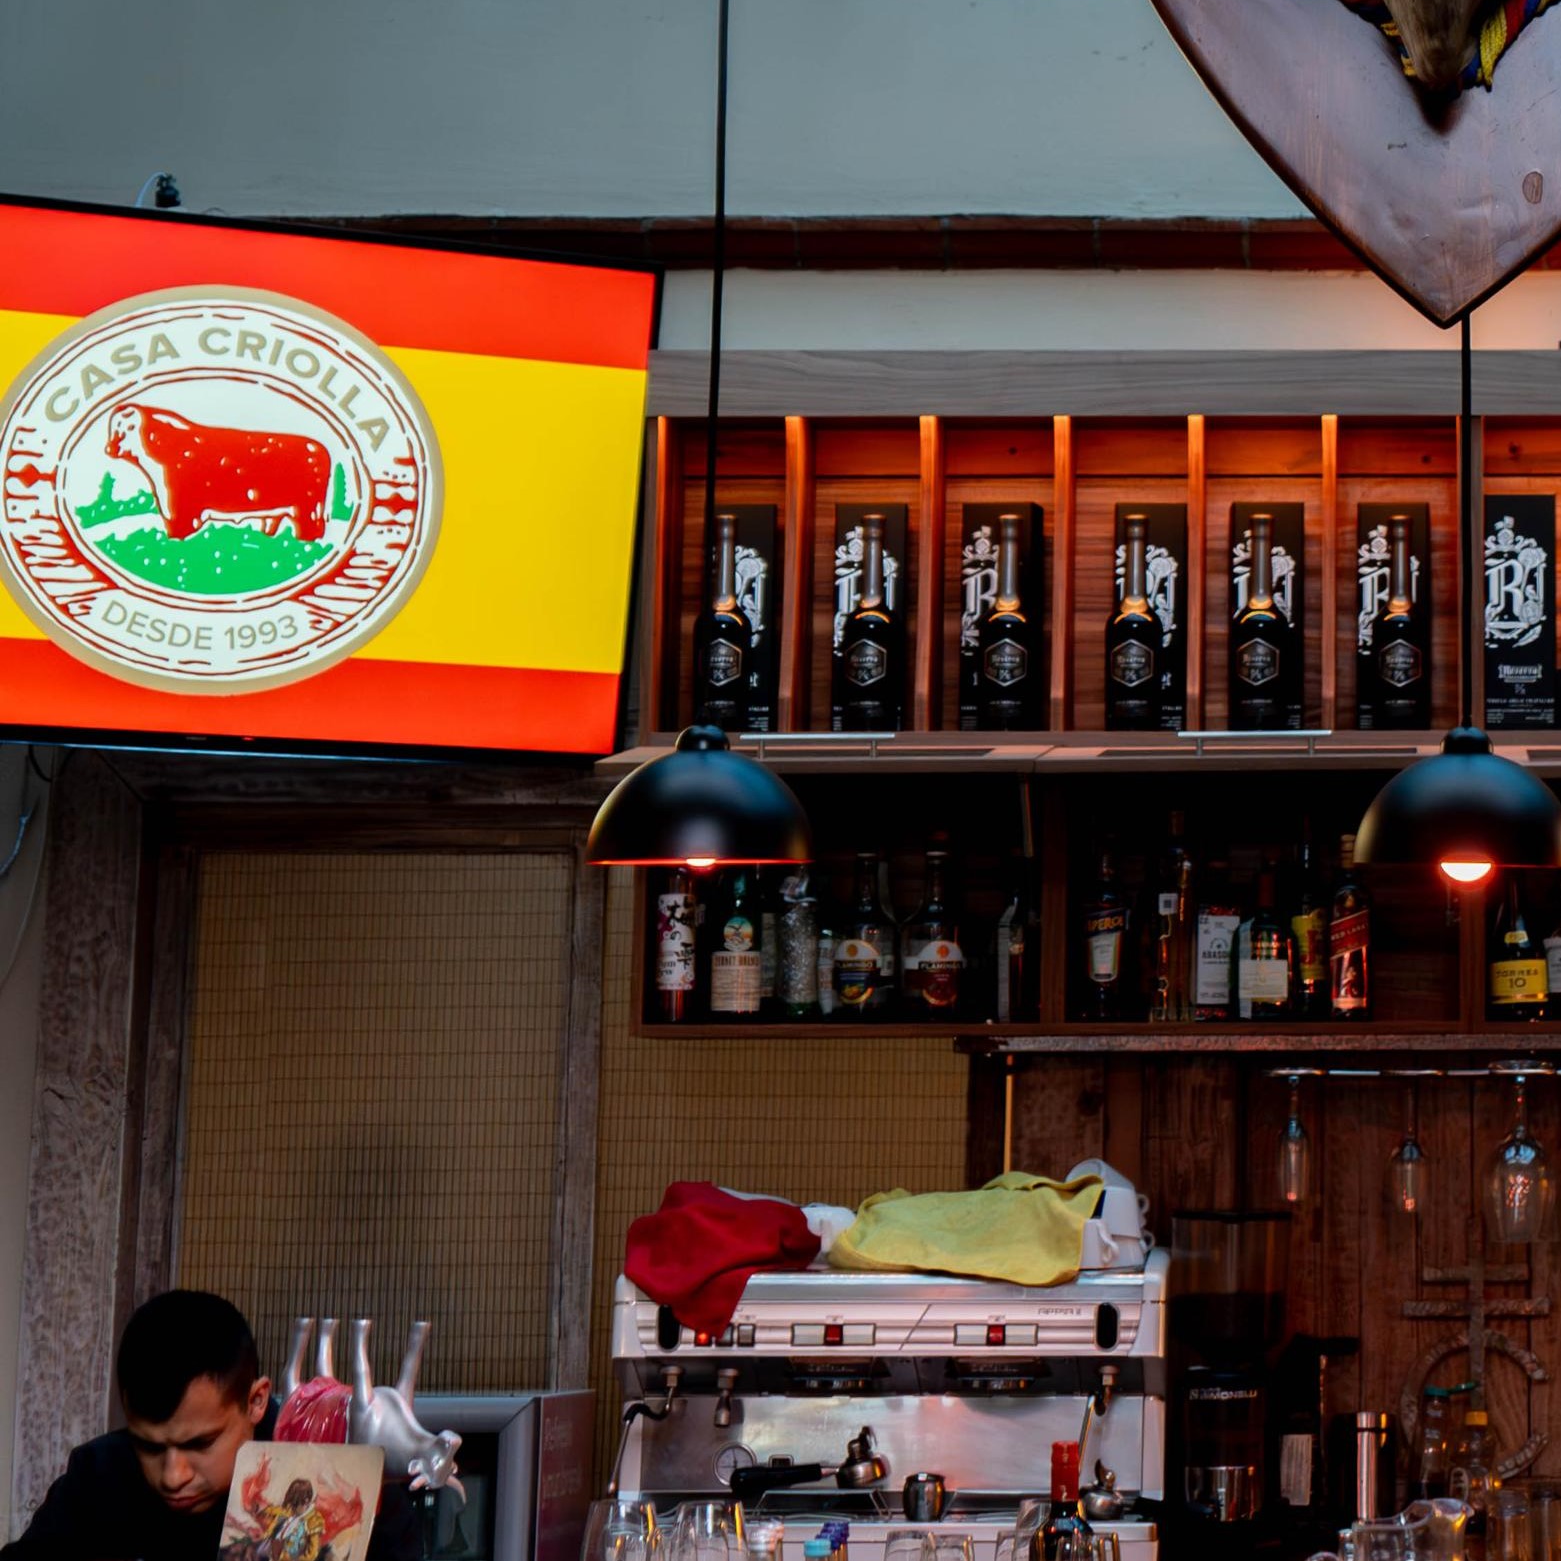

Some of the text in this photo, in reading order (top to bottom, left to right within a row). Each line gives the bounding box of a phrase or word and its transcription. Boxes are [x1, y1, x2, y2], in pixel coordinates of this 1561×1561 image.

[45, 326, 392, 453] CASA CRIOLLA
[101, 599, 299, 650] DESDE 1993
[1508, 977, 1527, 988] 10
